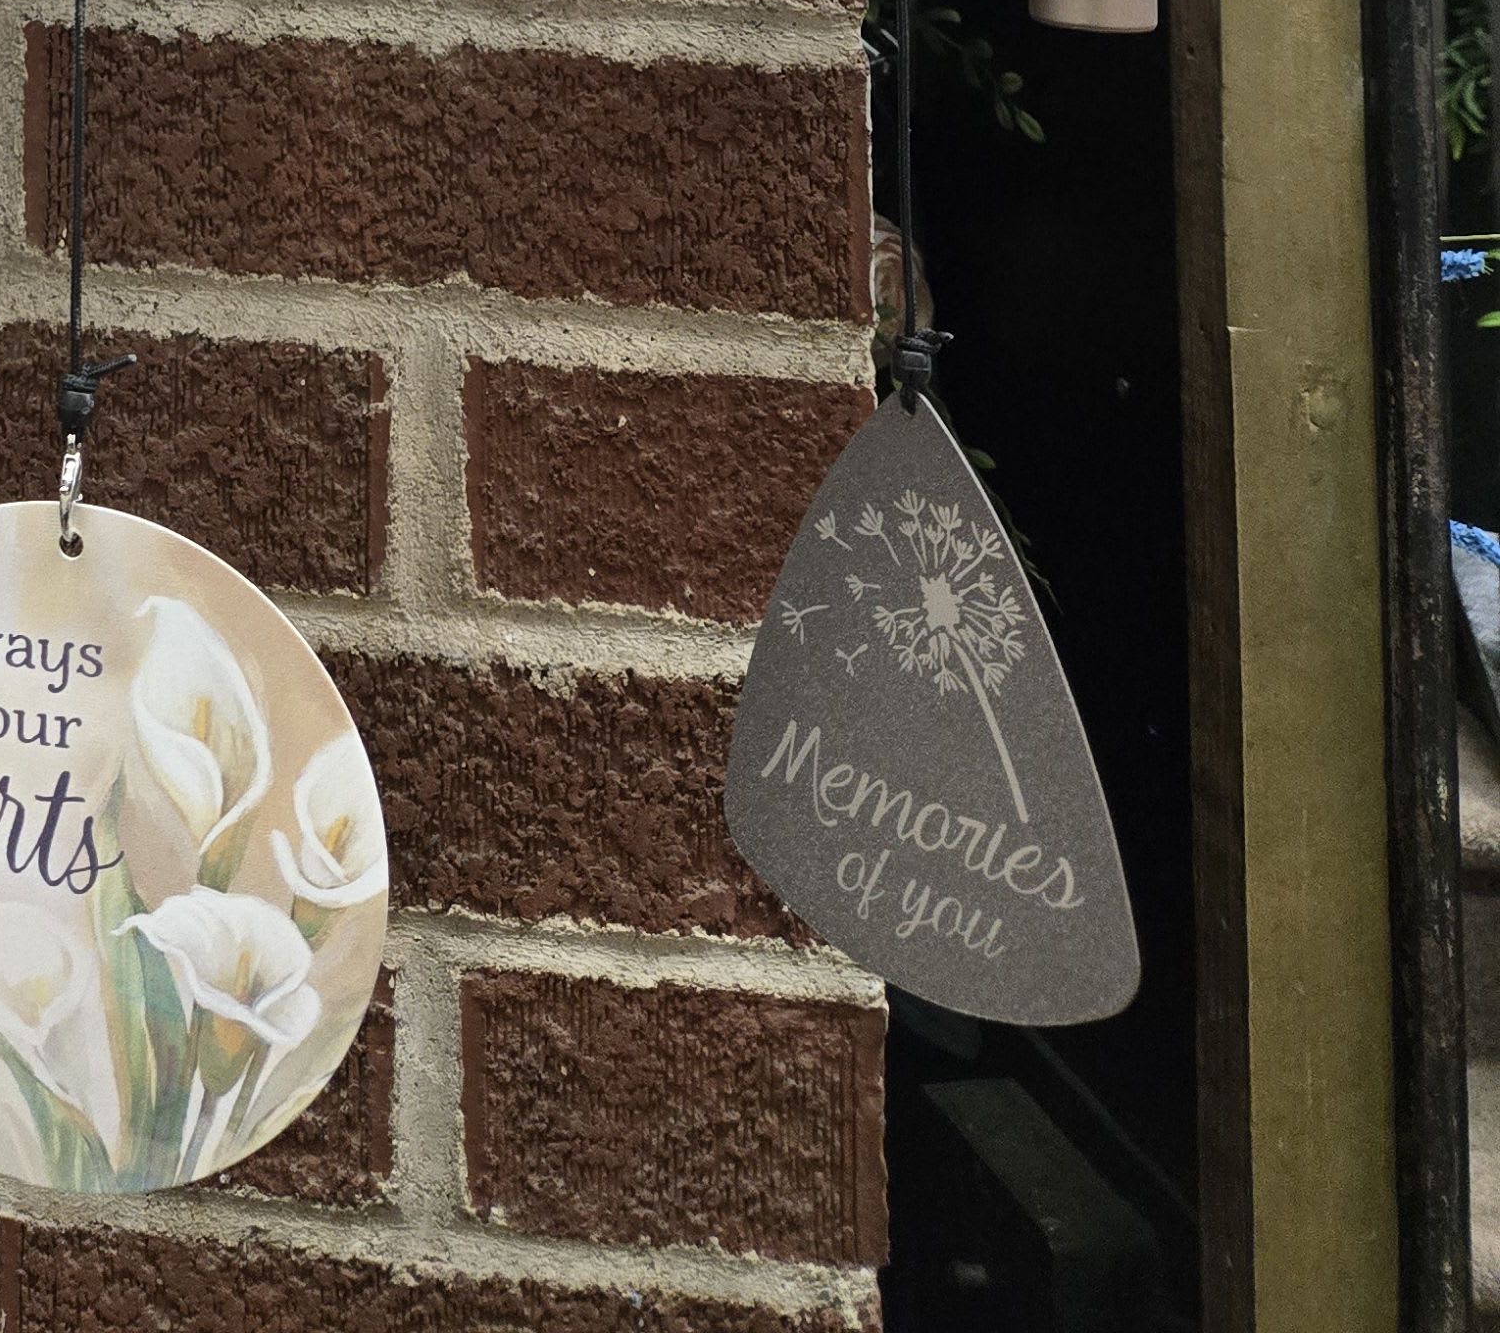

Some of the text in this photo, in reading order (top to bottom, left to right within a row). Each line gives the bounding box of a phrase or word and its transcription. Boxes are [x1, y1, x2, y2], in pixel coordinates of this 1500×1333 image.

[761, 718, 1085, 910] Memories
[836, 848, 1007, 960] of you
